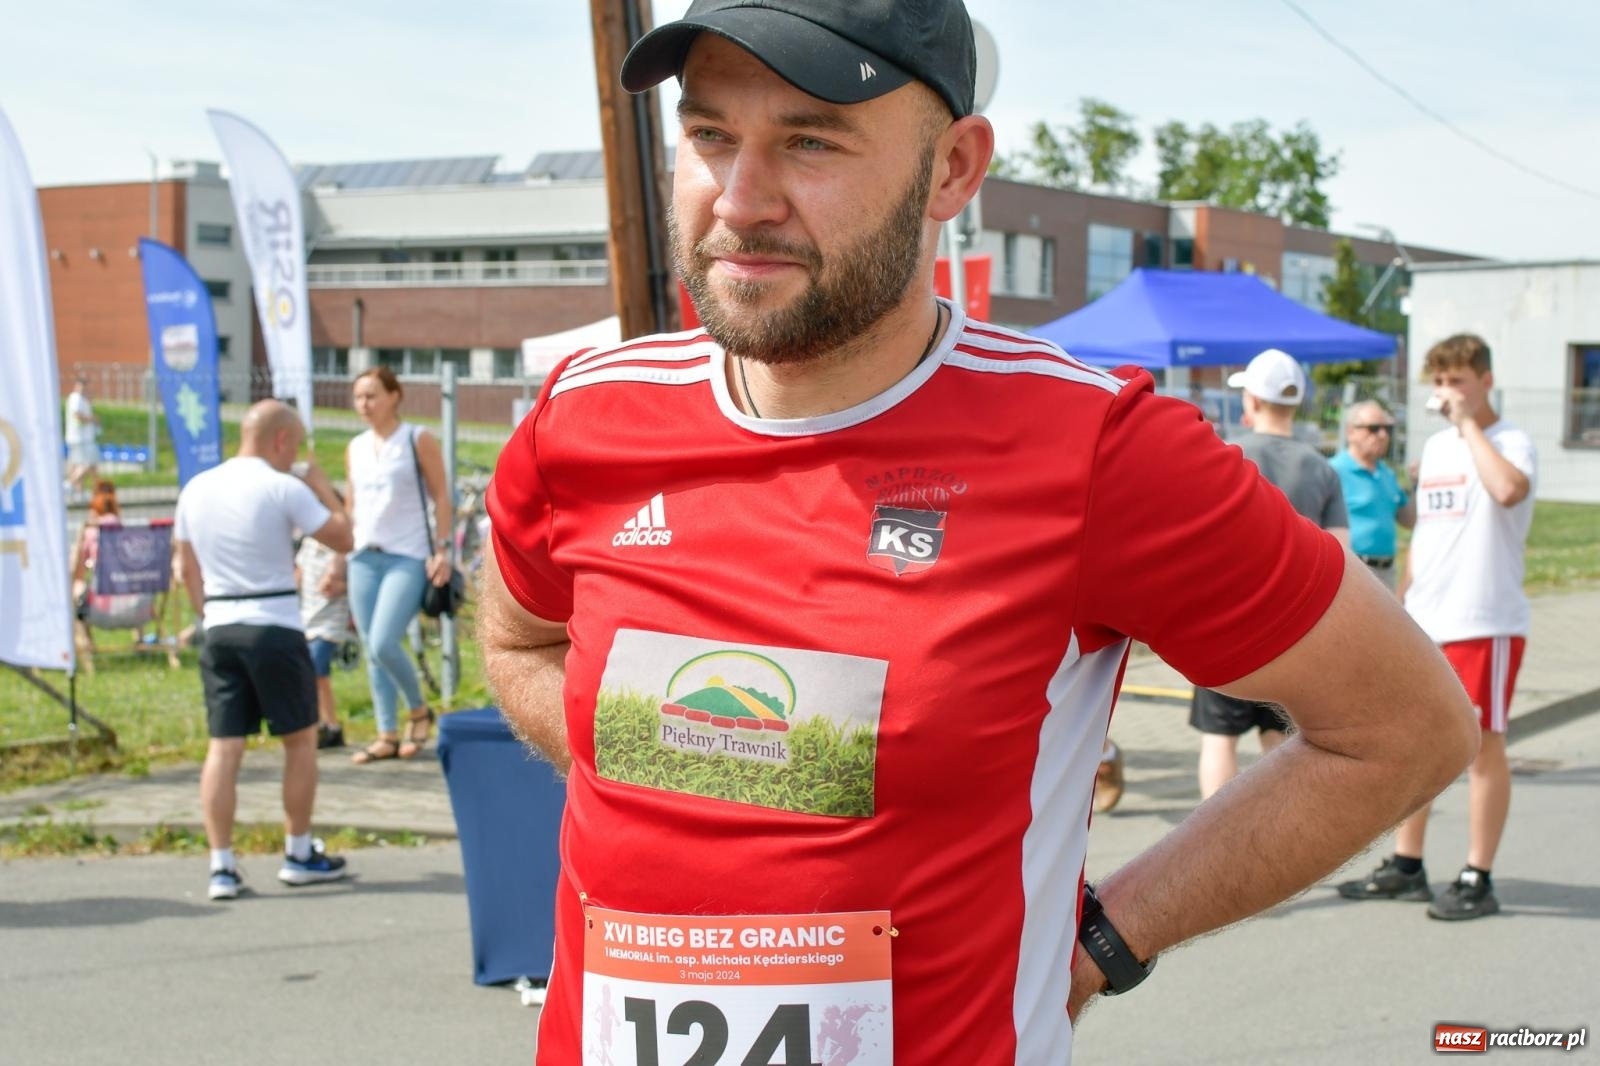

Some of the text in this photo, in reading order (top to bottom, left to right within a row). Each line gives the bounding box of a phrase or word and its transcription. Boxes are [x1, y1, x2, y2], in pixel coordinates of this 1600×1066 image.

[611, 526, 673, 547] adidas
[877, 524, 935, 558] KS
[662, 724, 787, 760] Piękny Trawnik
[603, 920, 846, 949] XVI BIEG BEZ GRANIC
[656, 954, 673, 964] im.
[674, 955, 700, 968] asp.
[701, 953, 751, 966] Michała
[753, 951, 844, 968] Kędzierskiego
[679, 970, 741, 982] 3 maja 2024
[624, 995, 823, 1066] 124
